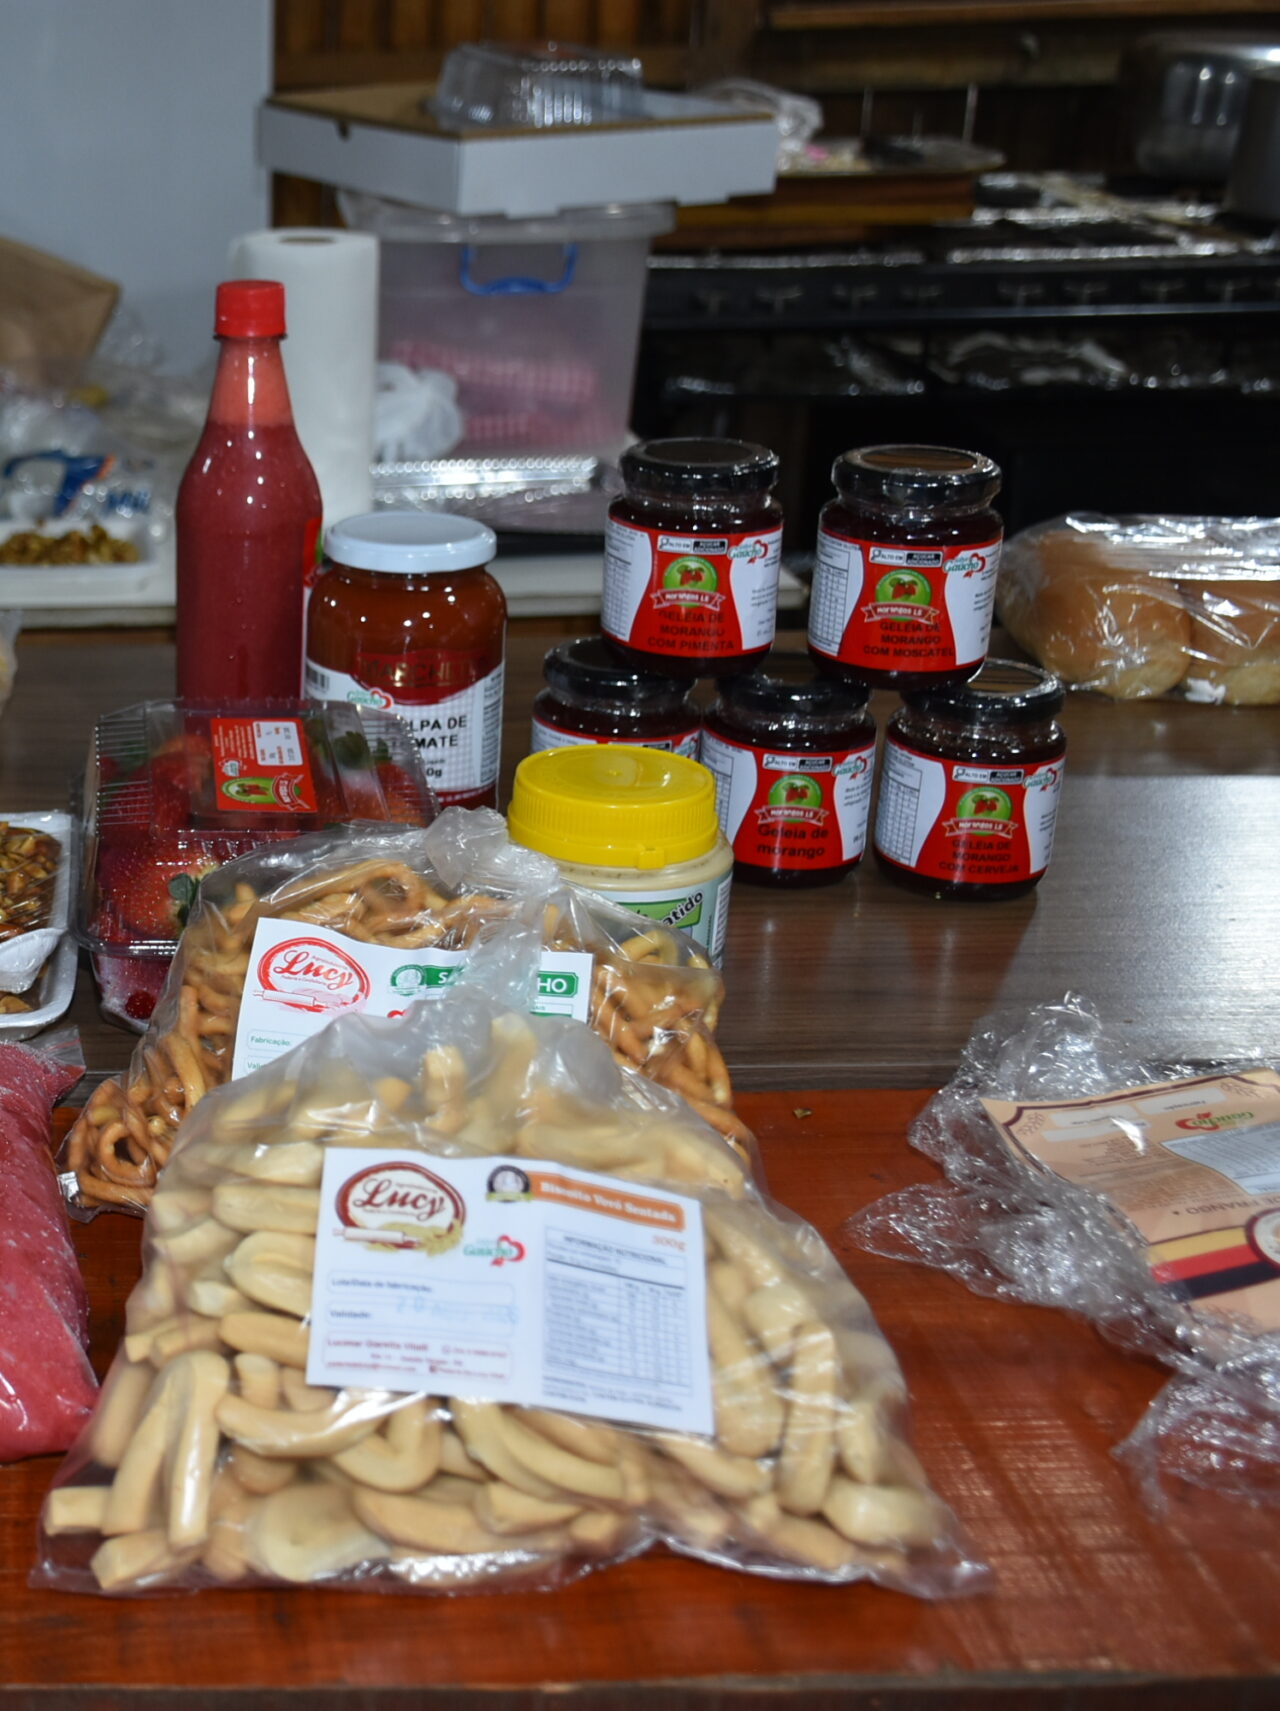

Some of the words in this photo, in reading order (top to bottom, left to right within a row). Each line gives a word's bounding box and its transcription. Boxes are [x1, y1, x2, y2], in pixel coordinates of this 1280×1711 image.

[708, 611, 724, 624] DE
[648, 636, 676, 649] COM
[680, 637, 734, 650] PIMENTA
[880, 633, 941, 645] MORANGO
[863, 644, 890, 656] COM
[893, 645, 954, 658] MOSCATEL
[447, 715, 468, 730] DE
[757, 825, 807, 840] Geleia
[811, 827, 828, 839] de
[757, 843, 825, 859] morango
[952, 851, 1012, 861] MORANGO
[970, 863, 1019, 873] CERVEJA
[273, 949, 354, 991] Lucy
[352, 1177, 447, 1222] Lucy
